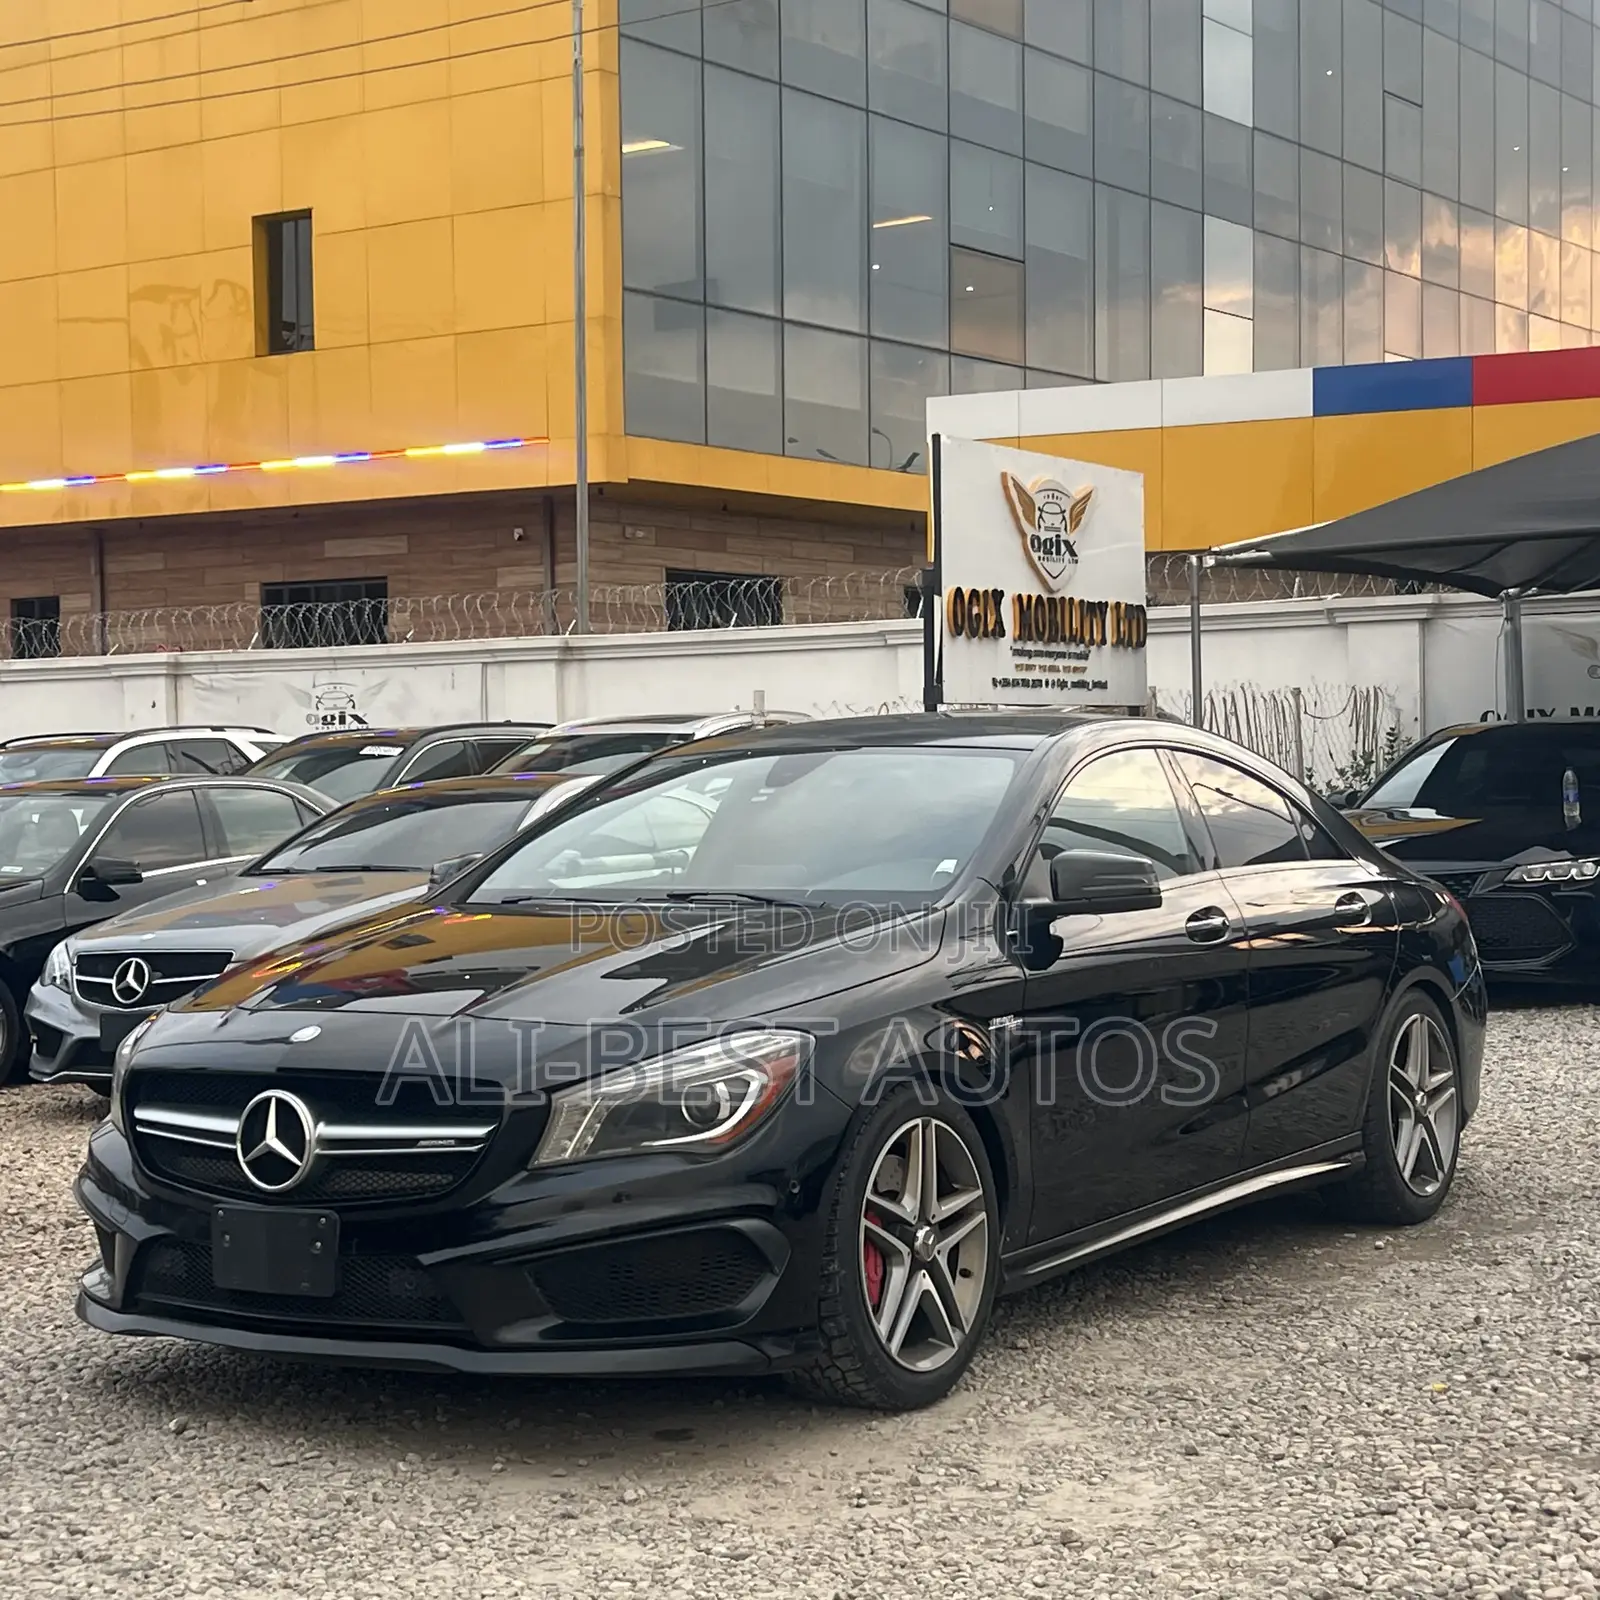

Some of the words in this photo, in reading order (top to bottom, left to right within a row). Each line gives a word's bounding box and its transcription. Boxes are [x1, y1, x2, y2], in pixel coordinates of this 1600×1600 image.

[948, 586, 1007, 638] OGIX
[1012, 593, 1109, 647] MOBILITY
[1110, 601, 1147, 649] LTD
